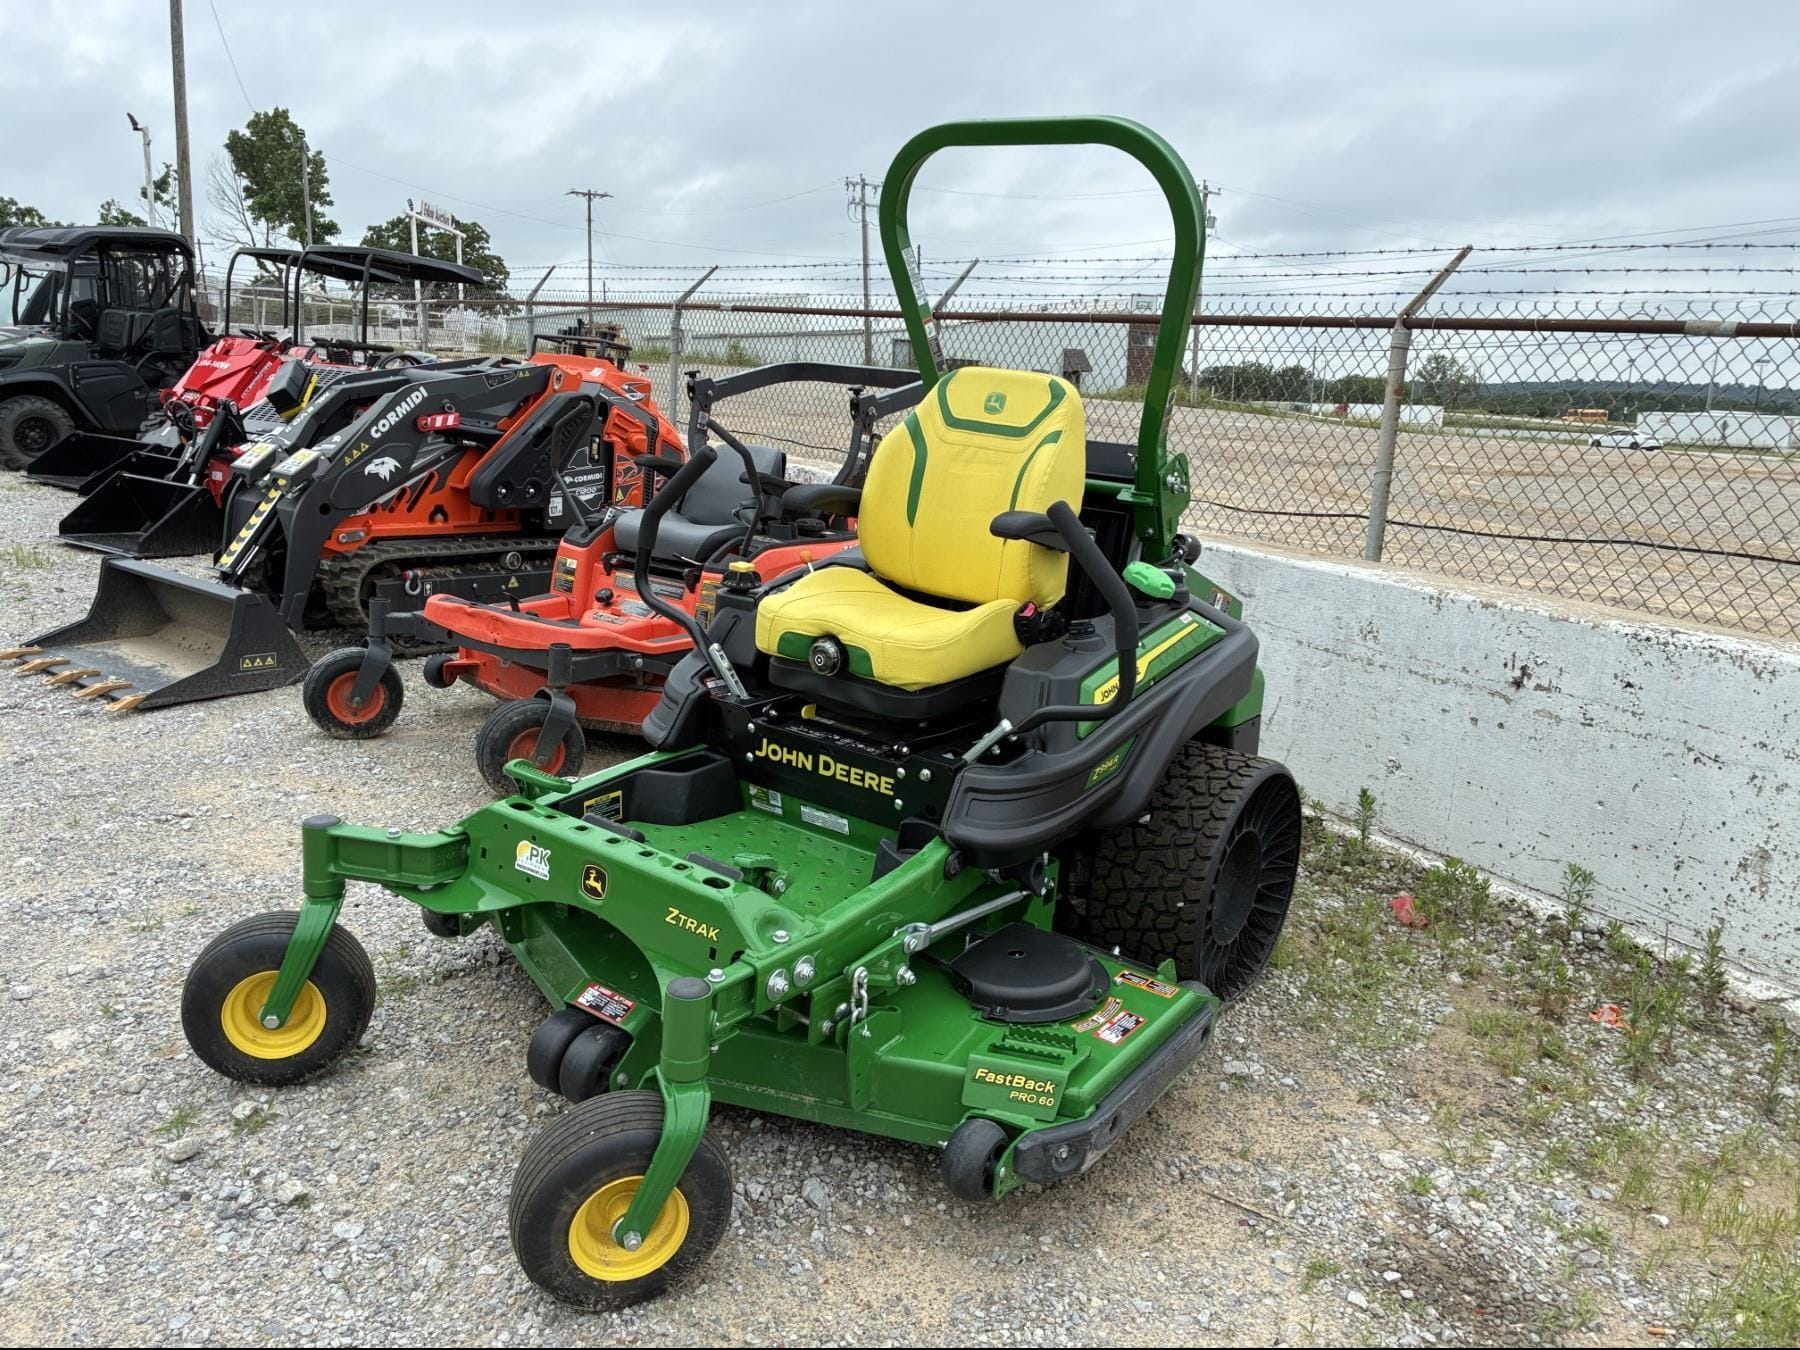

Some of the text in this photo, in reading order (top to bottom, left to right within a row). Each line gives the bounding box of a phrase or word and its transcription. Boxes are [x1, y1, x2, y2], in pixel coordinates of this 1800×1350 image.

[370, 386, 429, 439] CORMIDI
[574, 472, 603, 483] CORMIDI
[755, 737, 895, 797] JOHN DEERE
[664, 906, 721, 942] ZTRAK
[975, 1068, 1055, 1094] FastBack
[1009, 1091, 1055, 1107] PRO 60
